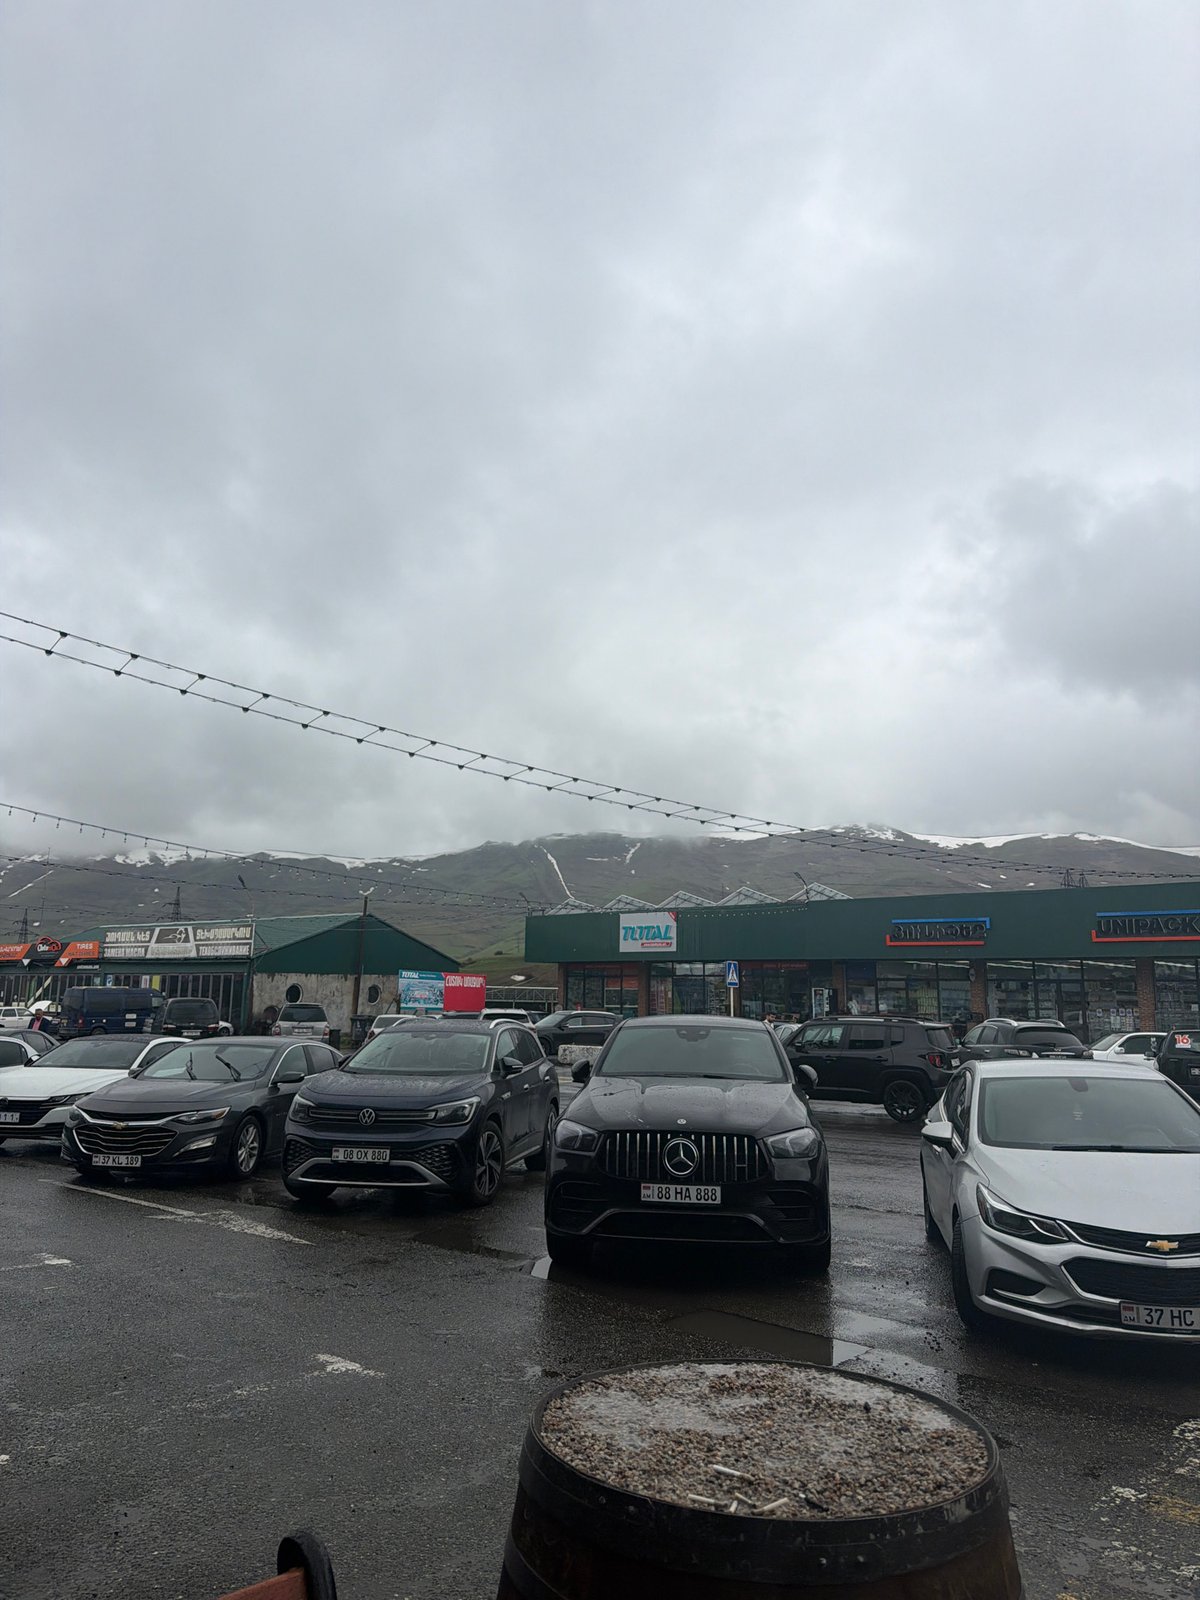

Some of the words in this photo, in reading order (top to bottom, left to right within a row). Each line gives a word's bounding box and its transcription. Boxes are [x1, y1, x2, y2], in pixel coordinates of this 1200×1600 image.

[622, 924, 673, 941] TOTAL
[401, 971, 419, 979] TOTAL
[1175, 1034, 1191, 1045] 16
[343, 1149, 354, 1160] 08
[356, 1150, 369, 1160] OX
[101, 1155, 110, 1165] 37
[112, 1156, 123, 1165] KL
[124, 1156, 139, 1166] 189
[657, 1186, 671, 1200] 88
[674, 1187, 691, 1201] HA
[695, 1188, 718, 1202] 888
[1144, 1307, 1164, 1325] 37
[1170, 1309, 1194, 1327] HC
